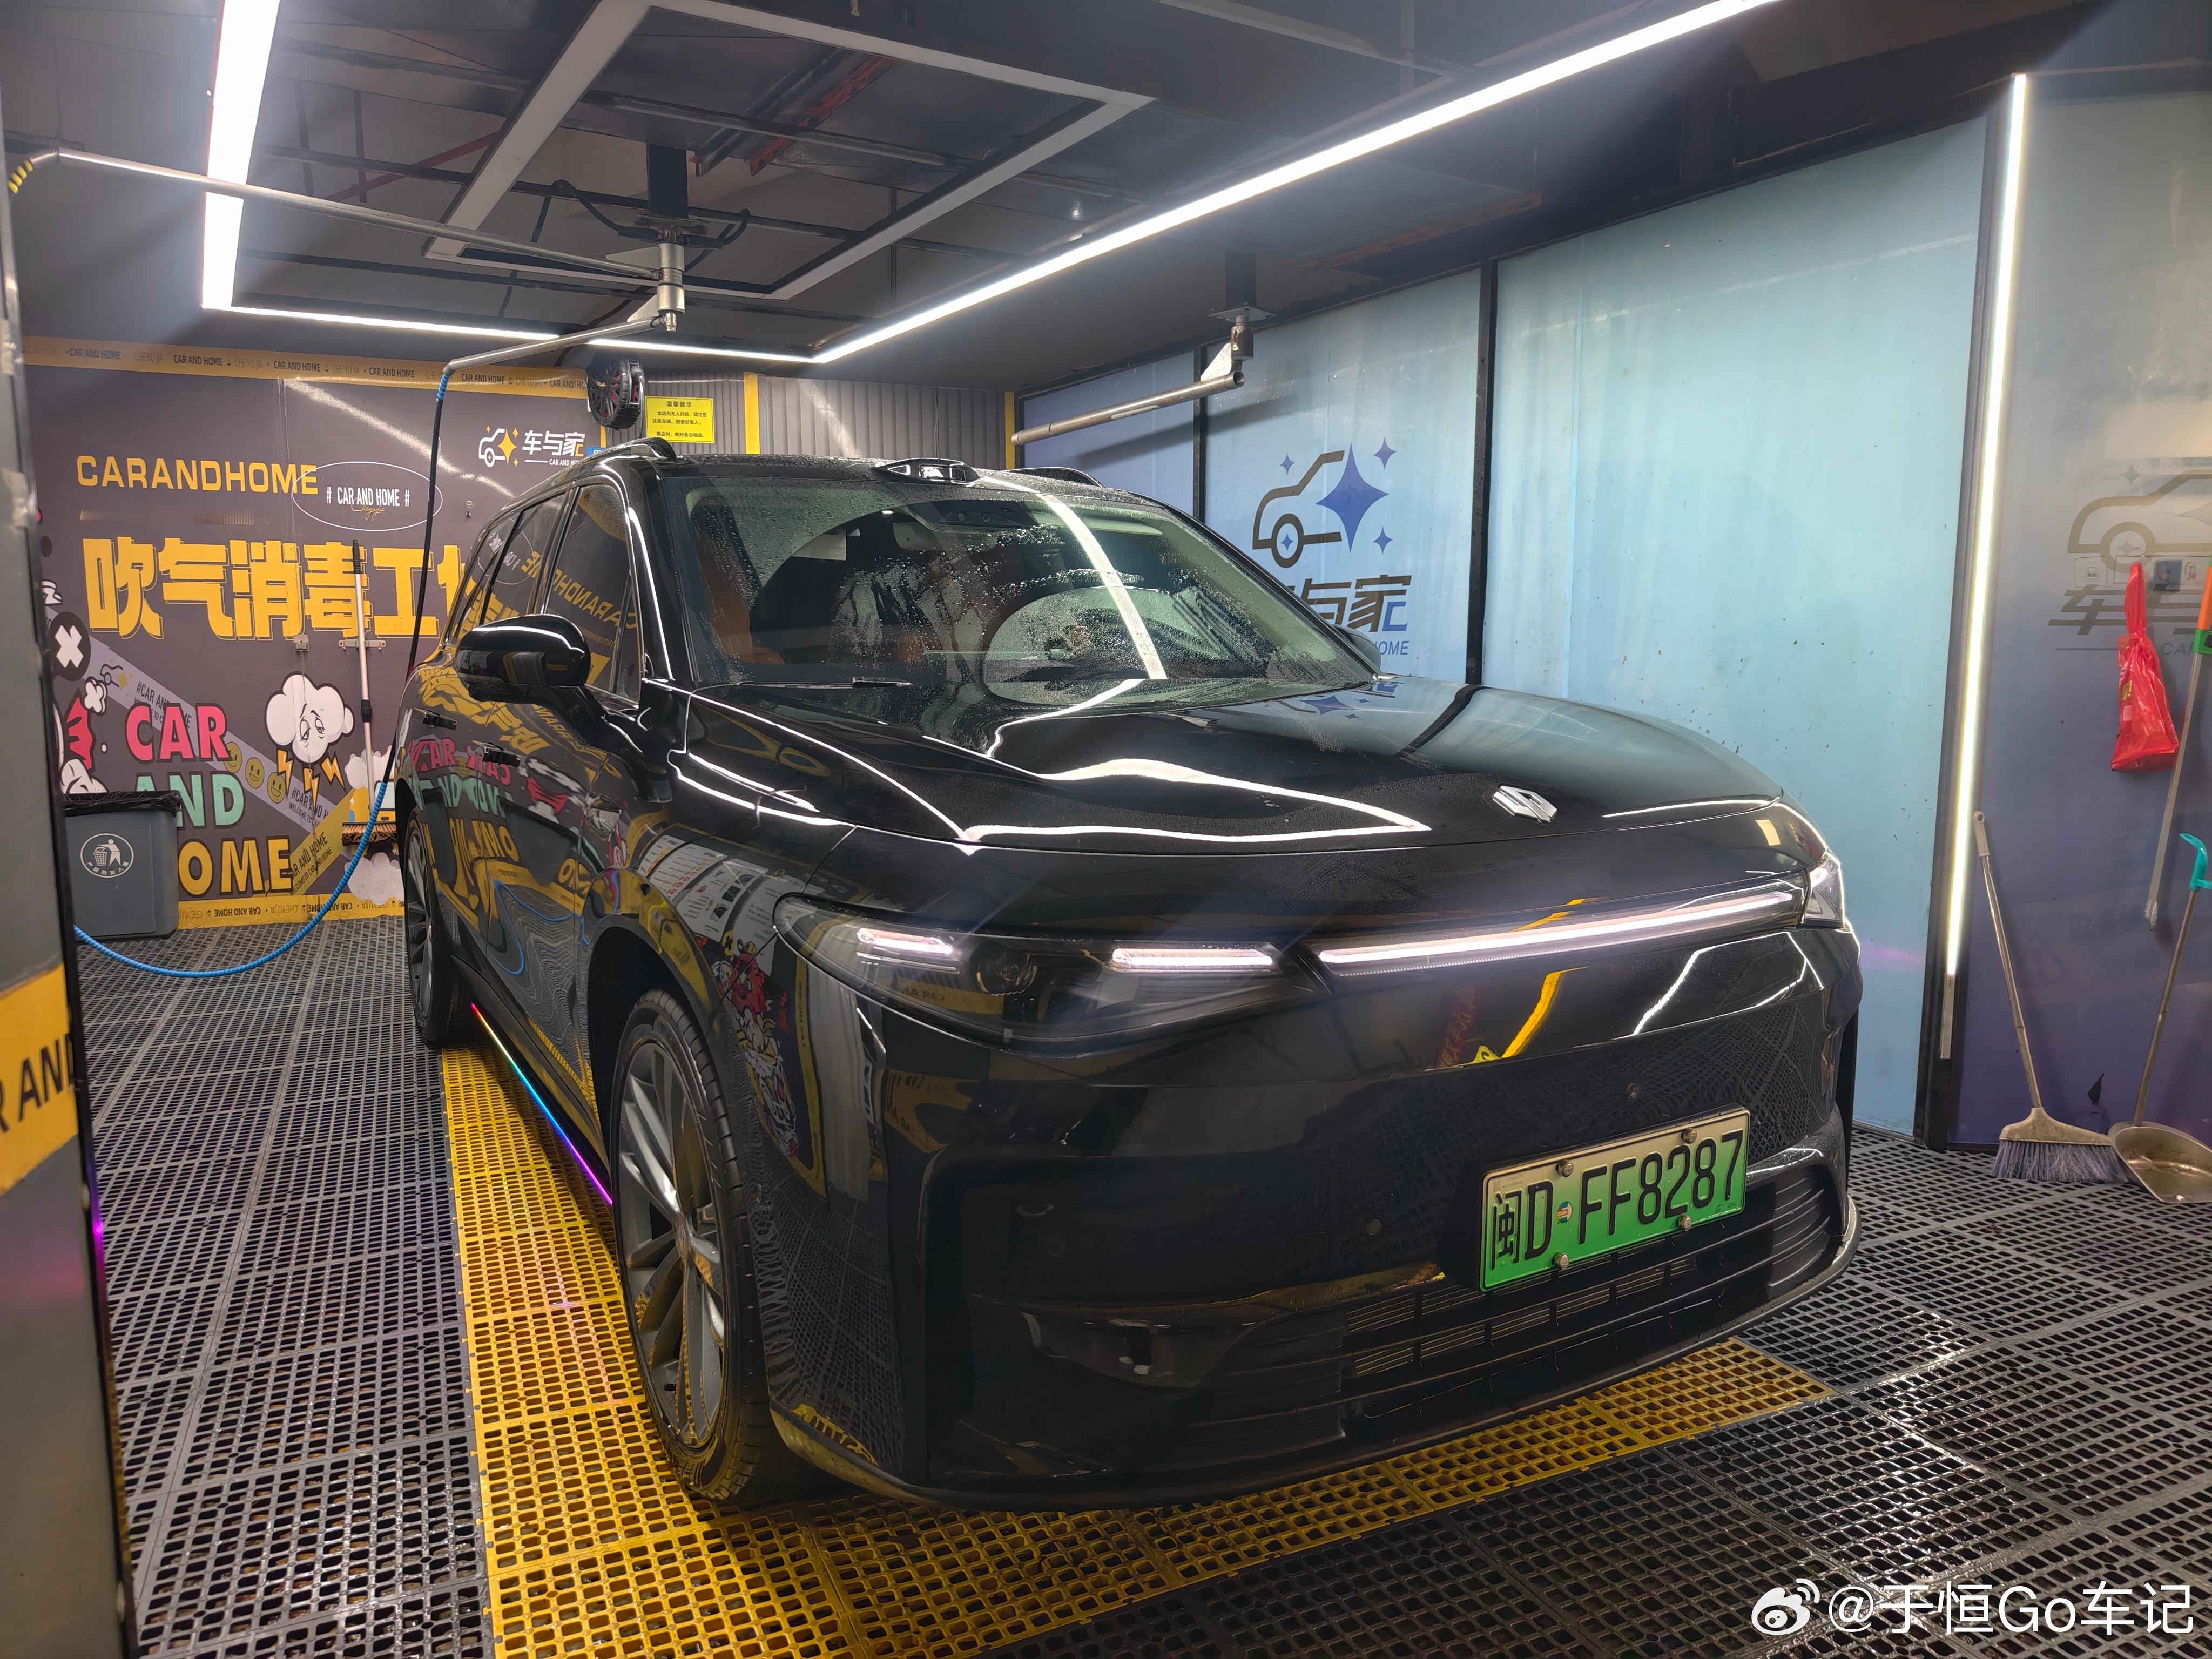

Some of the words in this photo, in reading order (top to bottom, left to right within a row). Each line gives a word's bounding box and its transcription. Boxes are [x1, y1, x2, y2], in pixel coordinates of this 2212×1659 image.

[70, 348, 83, 358] CAR
[173, 354, 186, 364] CAR
[188, 355, 202, 365] AND
[203, 356, 222, 366] HOME
[274, 360, 286, 369] CAR
[287, 361, 301, 370] AND
[302, 362, 320, 372] HOME
[369, 367, 381, 376] CAR
[382, 368, 395, 377] AND
[396, 368, 415, 378] HOME
[461, 373, 473, 382] CAR
[474, 374, 487, 383] AND
[488, 375, 505, 385] HOME
[550, 379, 561, 388] CAR
[522, 430, 585, 457] 车与家
[76, 455, 319, 494] CARANDHOME
[337, 487, 354, 504] CAR
[356, 488, 373, 505] AND
[376, 488, 400, 507] HOME
[1285, 574, 1412, 632] 与家
[1375, 640, 1410, 655] OME
[2162, 643, 2194, 655] CA
[125, 704, 231, 763] CAR
[289, 802, 306, 822] WELCOME
[299, 848, 311, 870] AND
[309, 832, 328, 857] HOME
[178, 838, 294, 896] OME
[214, 908, 232, 917] HOME
[234, 908, 247, 916] AND
[249, 907, 261, 915] CAR
[1577, 1129, 1744, 1245] FF8287
